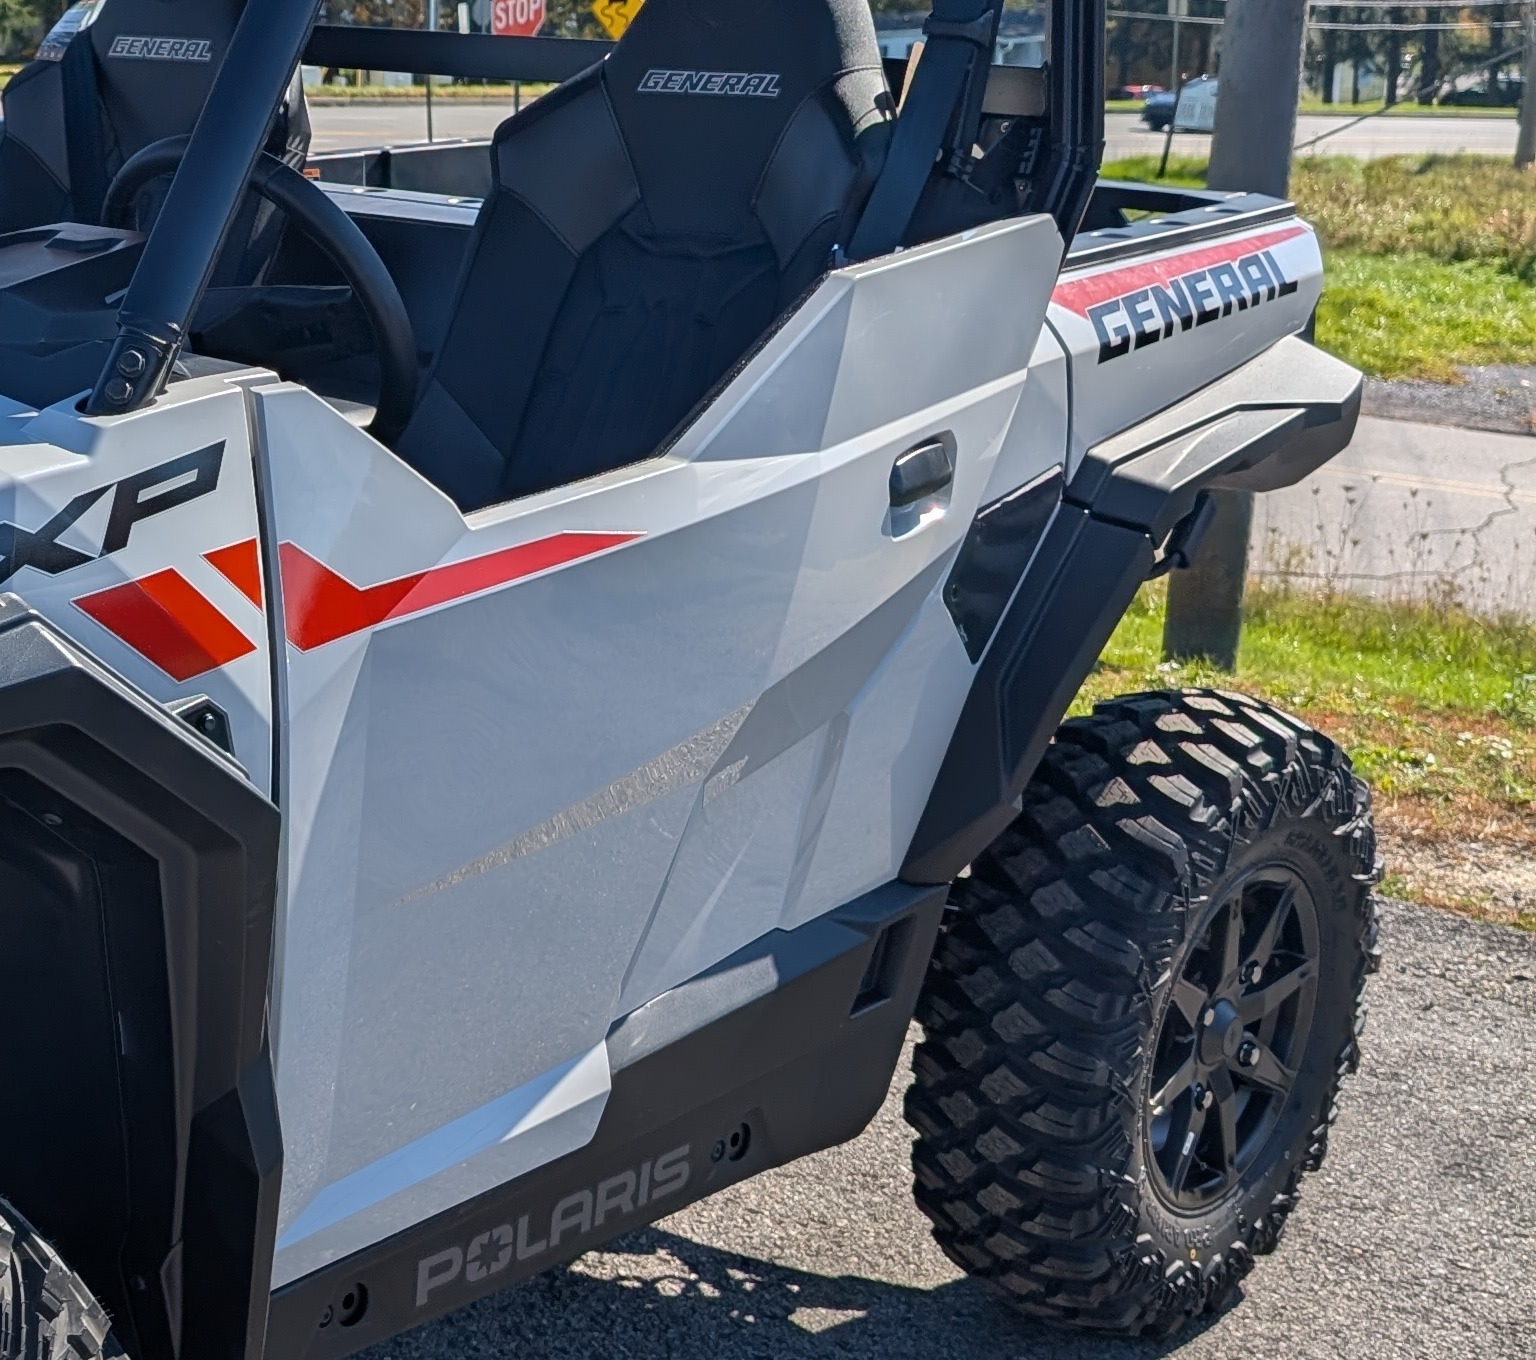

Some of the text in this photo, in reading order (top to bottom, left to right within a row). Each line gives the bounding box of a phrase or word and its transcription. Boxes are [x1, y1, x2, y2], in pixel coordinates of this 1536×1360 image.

[107, 35, 212, 61] GENERAL
[636, 68, 781, 98] GENERAL
[1086, 251, 1300, 365] GENERAL
[415, 1143, 691, 1308] POLARIS
